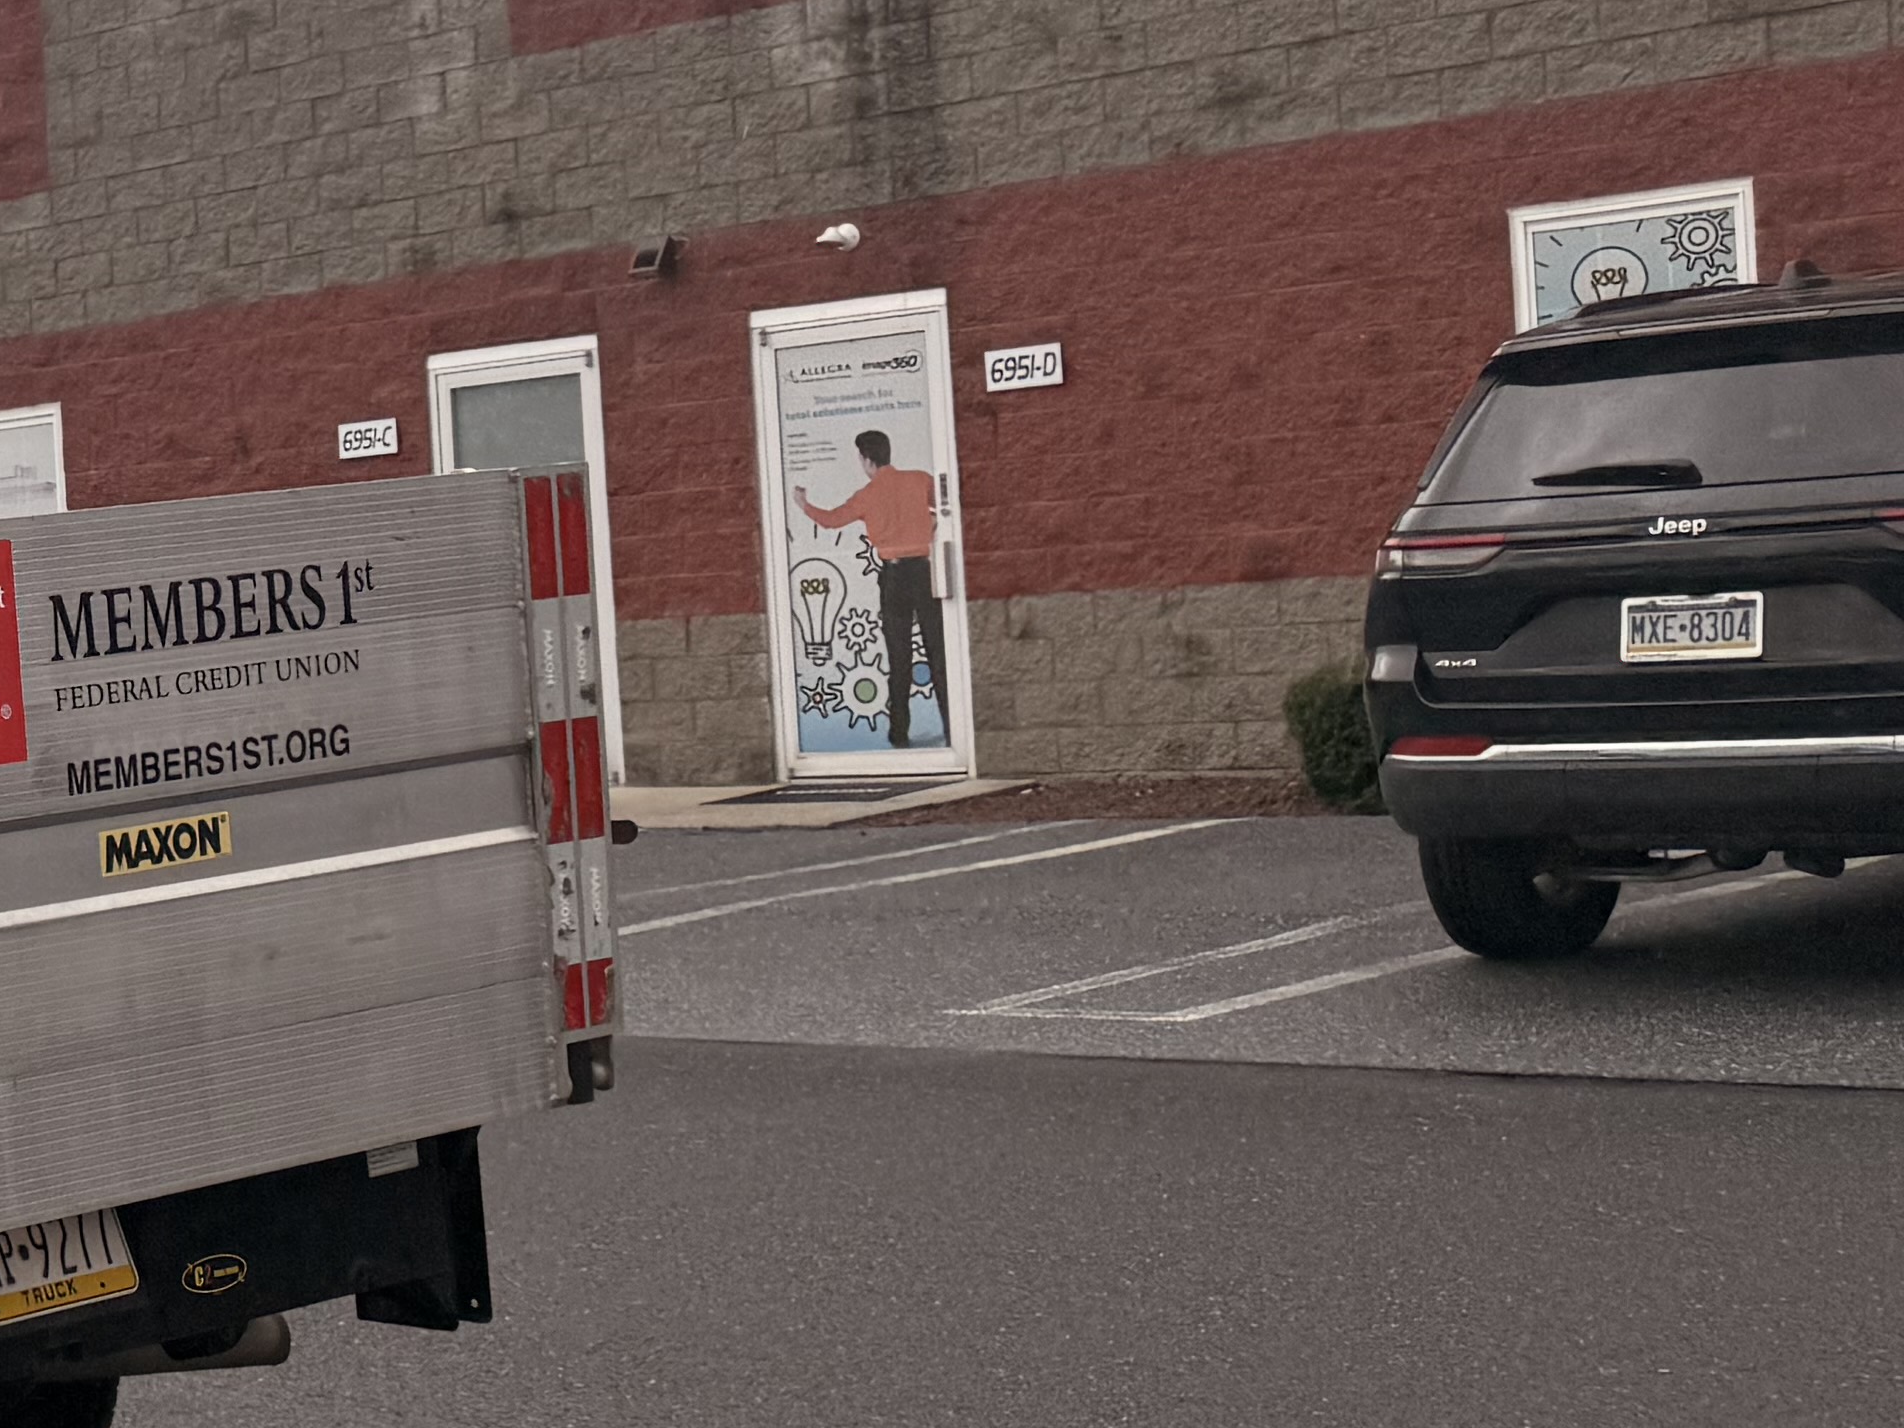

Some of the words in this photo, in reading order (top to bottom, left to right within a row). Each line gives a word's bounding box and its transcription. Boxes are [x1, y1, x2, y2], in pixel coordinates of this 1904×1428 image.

[990, 352, 1057, 383] 6951-D
[343, 425, 392, 452] 6951-C
[1648, 516, 1708, 536] Jeep
[49, 564, 327, 663] MEMBERS
[55, 677, 170, 712] FEDERAL
[176, 661, 267, 695] CREDIT
[275, 649, 361, 682] UNION
[67, 724, 351, 797] MEMBERS1ST.ORG
[105, 817, 222, 873] MAXON
[20, 1278, 78, 1307] TRUCK
